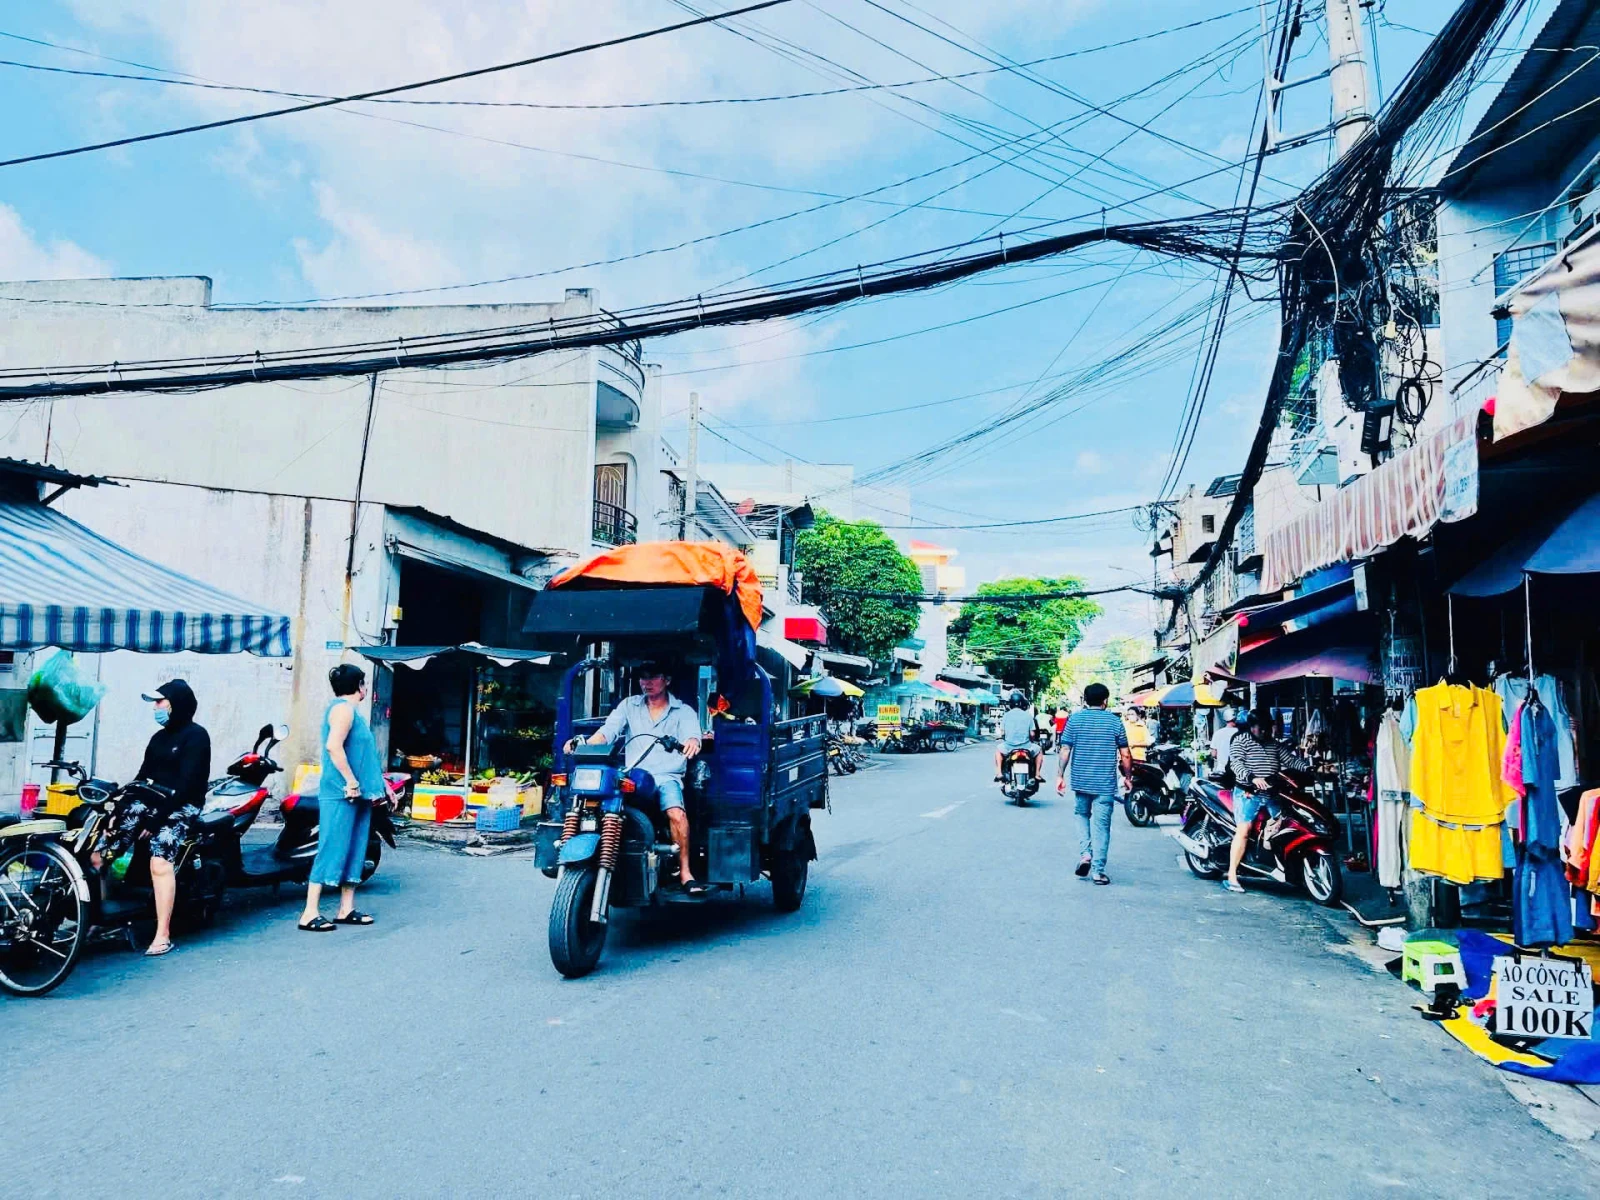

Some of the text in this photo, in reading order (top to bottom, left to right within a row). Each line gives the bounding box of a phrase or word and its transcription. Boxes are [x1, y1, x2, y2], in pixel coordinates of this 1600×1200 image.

[1526, 963, 1569, 987] CÔNG
[1512, 986, 1580, 1005] SALE
[1503, 1005, 1592, 1036] 100K
